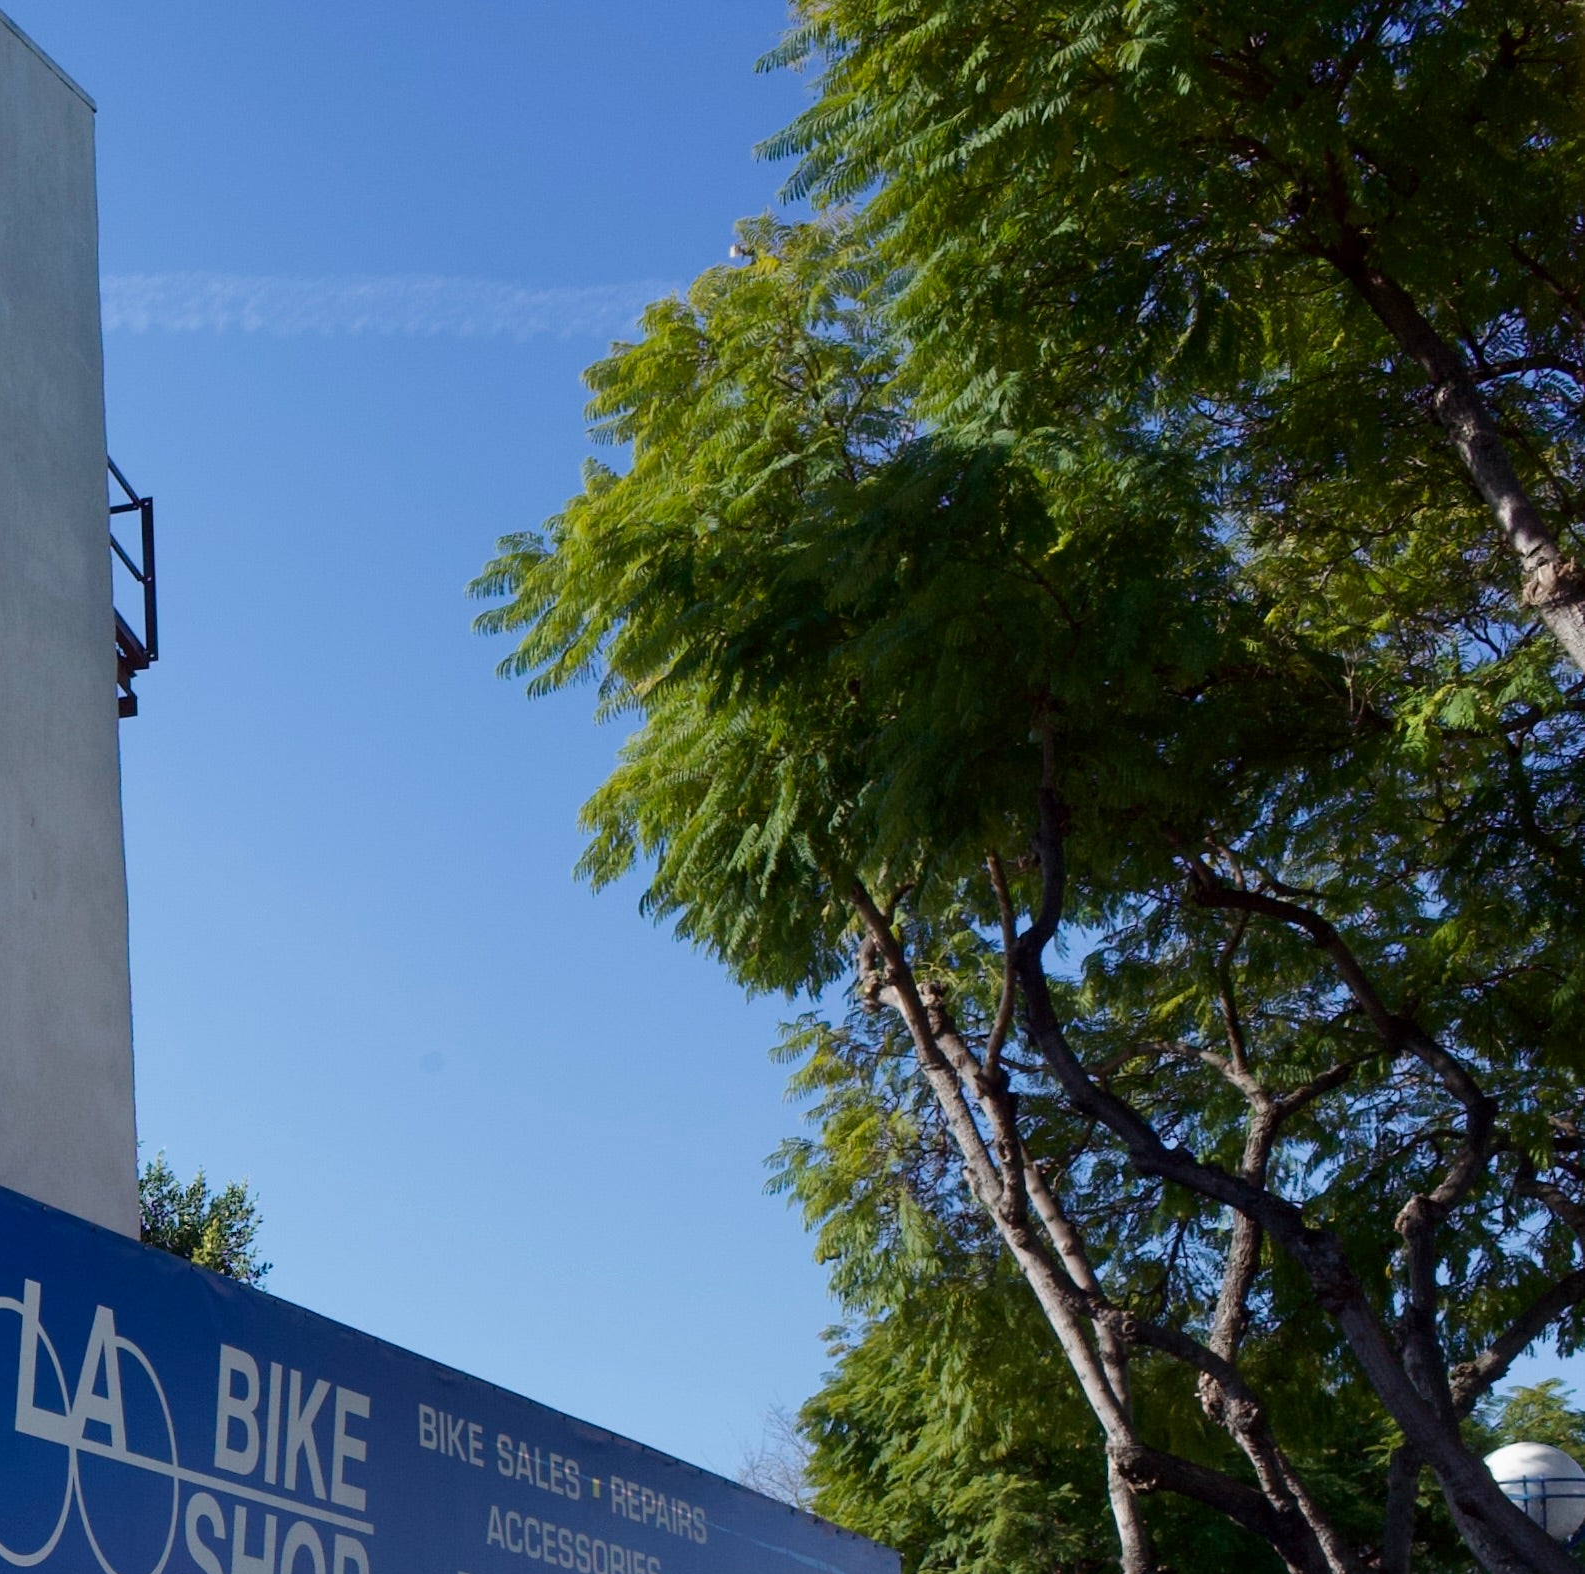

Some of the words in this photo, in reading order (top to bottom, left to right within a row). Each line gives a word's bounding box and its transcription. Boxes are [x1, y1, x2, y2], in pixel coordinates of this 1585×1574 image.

[15, 1278, 128, 1458] LA
[214, 1343, 371, 1513] BIKE
[419, 1403, 485, 1467] BIKE
[497, 1434, 581, 1501] SALES
[611, 1475, 707, 1545] REPAIRS
